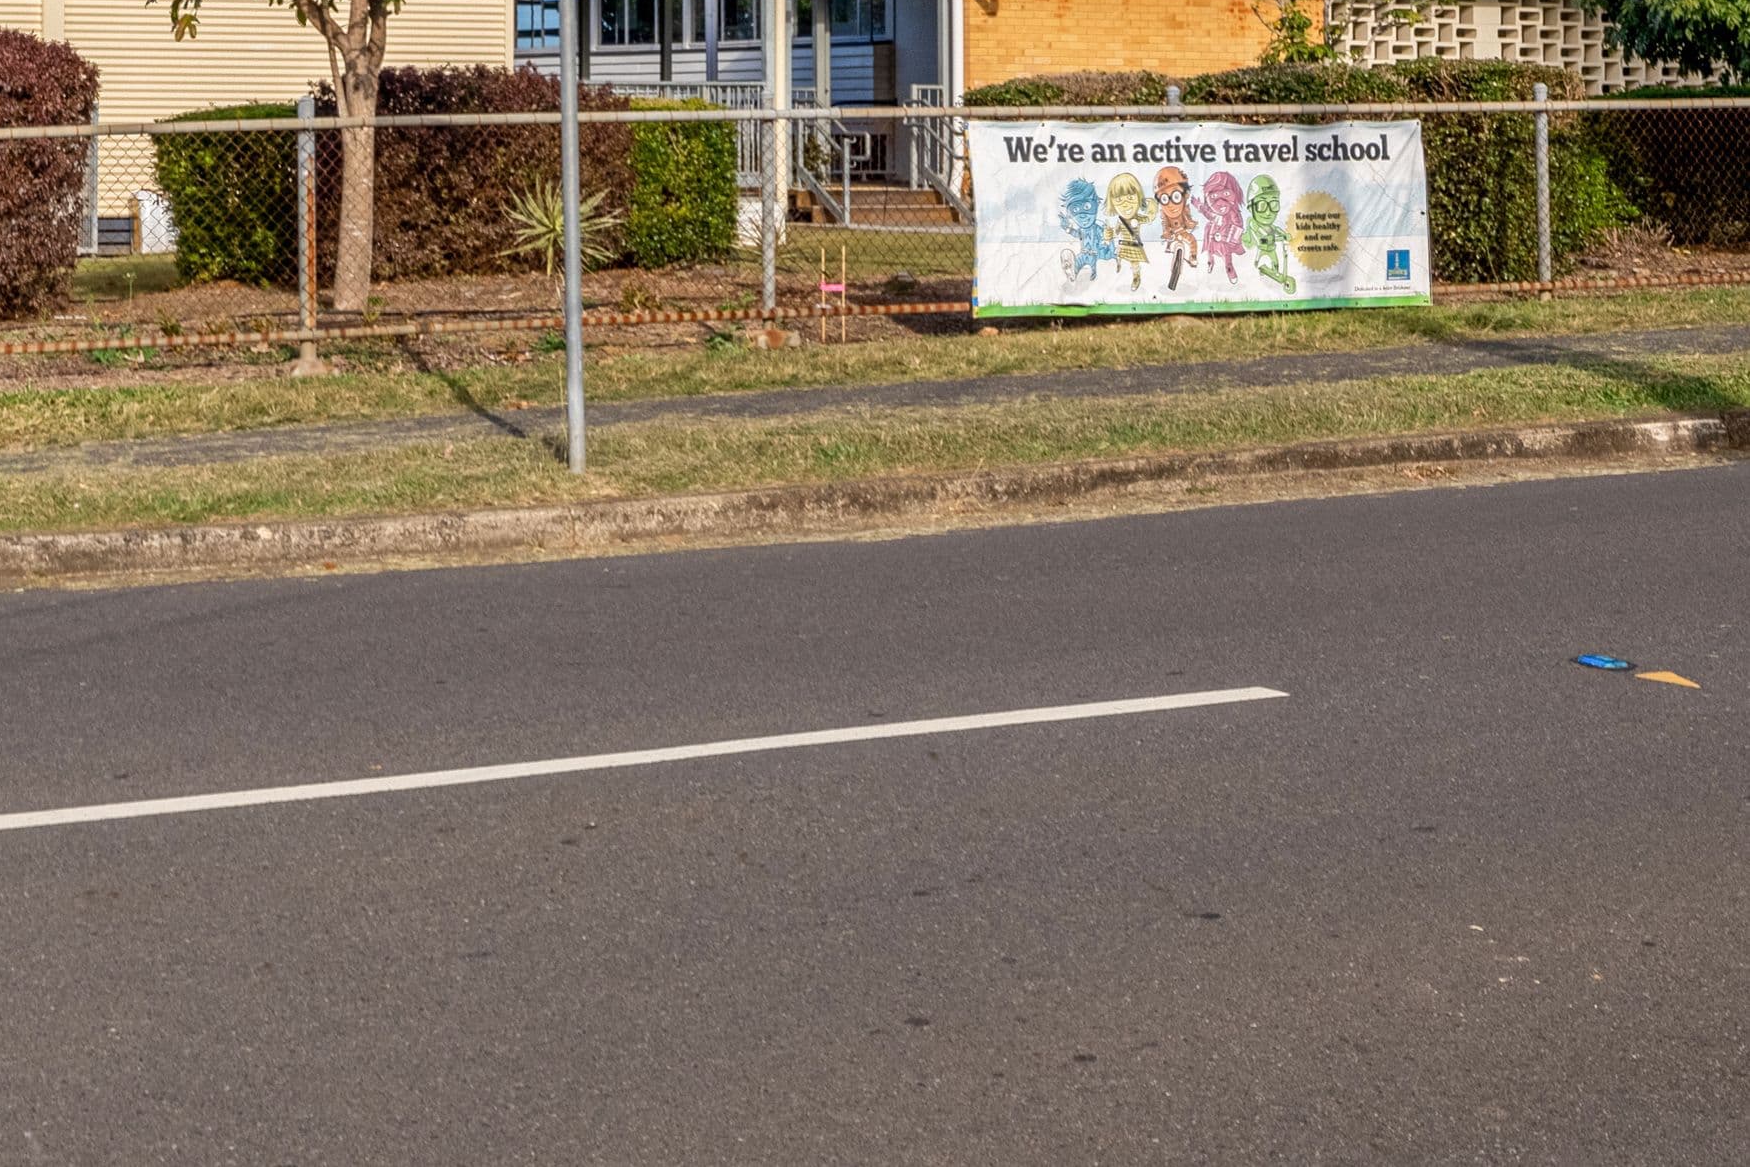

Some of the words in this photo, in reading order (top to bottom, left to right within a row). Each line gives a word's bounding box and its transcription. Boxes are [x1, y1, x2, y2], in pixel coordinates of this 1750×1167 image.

[1003, 135, 1085, 162] We're
[1091, 143, 1127, 162] an
[1132, 136, 1216, 162] active
[1223, 135, 1299, 162] travel
[1305, 134, 1390, 161] school
[1295, 212, 1326, 221] Keeping
[1295, 222, 1311, 230] kids
[1312, 222, 1341, 232] healthy
[1304, 233, 1318, 241] and
